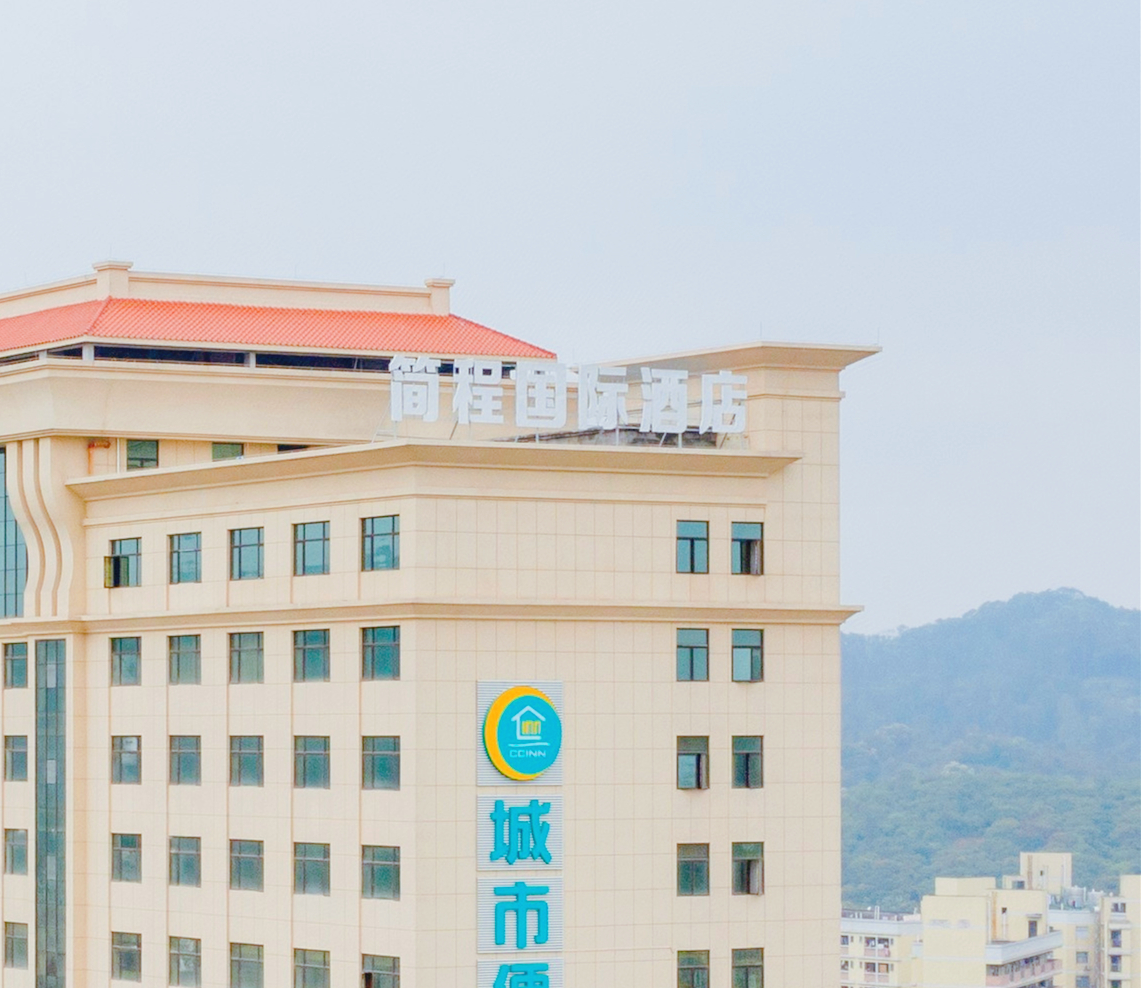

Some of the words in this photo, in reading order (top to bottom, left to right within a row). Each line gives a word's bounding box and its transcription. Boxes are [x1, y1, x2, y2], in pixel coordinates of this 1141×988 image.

[389, 354, 748, 434] 简程国际酒店
[509, 749, 546, 758] CCINN
